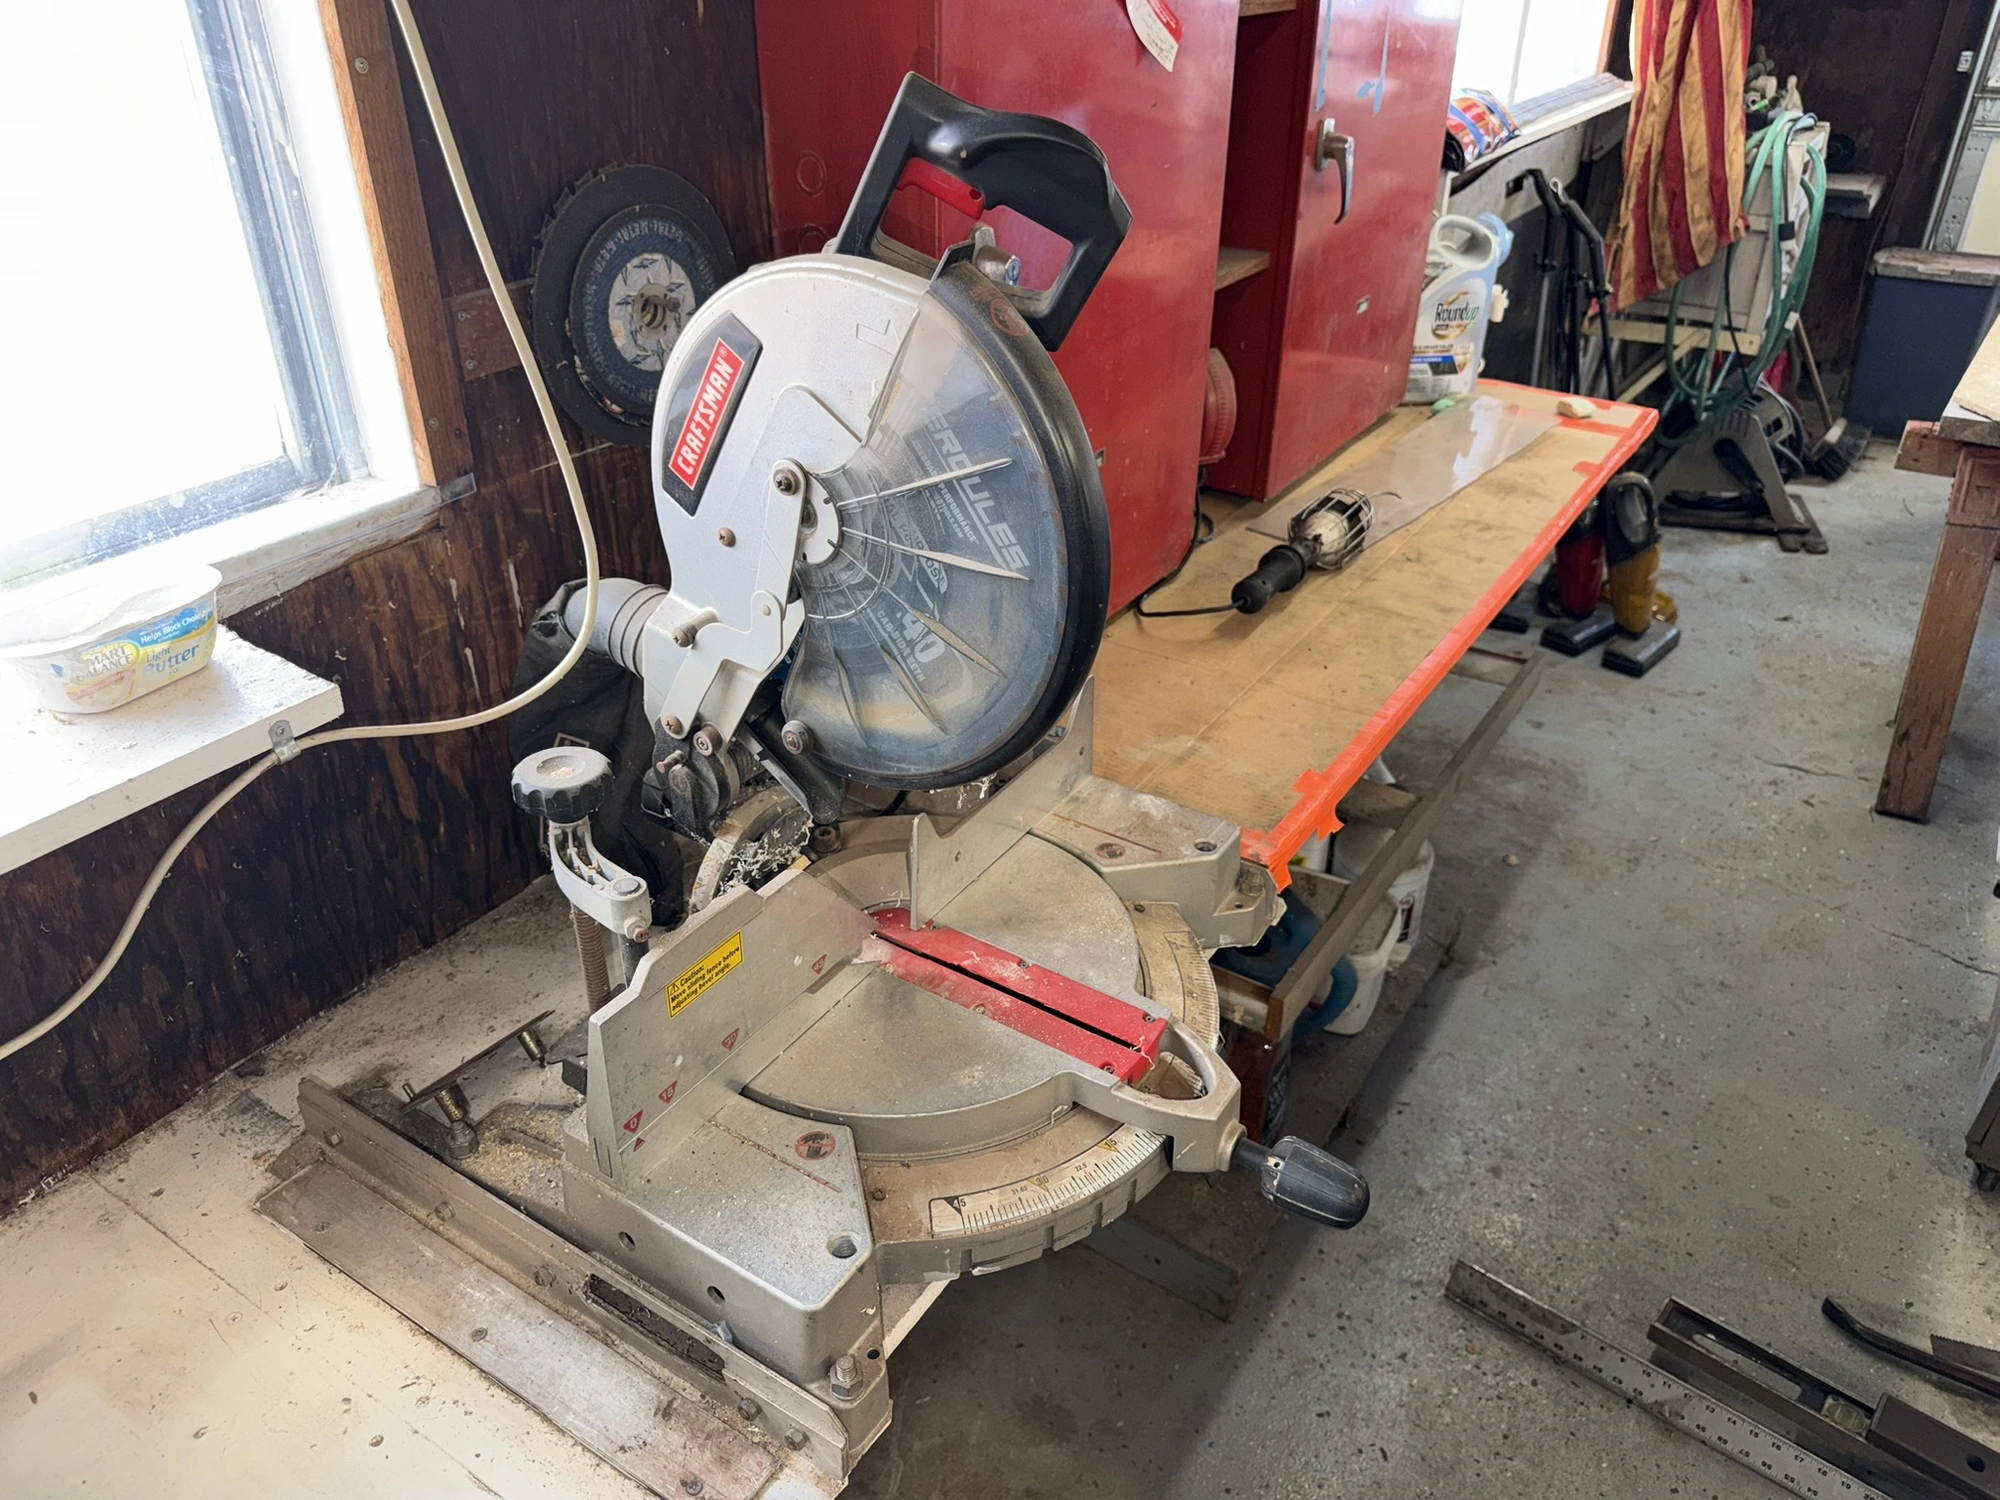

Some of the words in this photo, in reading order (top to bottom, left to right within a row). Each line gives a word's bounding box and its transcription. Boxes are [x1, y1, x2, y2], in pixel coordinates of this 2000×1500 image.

[1434, 301, 1480, 324] Roundup
[676, 356, 734, 475] CRAFTSMAN
[922, 405, 1031, 570] ERCULES
[140, 631, 162, 644] Helps
[162, 621, 181, 635] Block
[896, 611, 946, 663] 40
[87, 643, 129, 667] MART
[146, 646, 171, 663] Light
[671, 988, 686, 1003] Move
[687, 973, 706, 990] sliding
[706, 960, 722, 975] fence
[722, 946, 740, 963] before
[672, 987, 698, 1011] adjusting
[698, 973, 714, 990] bevel
[680, 964, 705, 987] Caution:
[661, 1086, 674, 1101] 15
[952, 1198, 967, 1210] 45
[1104, 1138, 1118, 1149] 15
[1727, 1417, 1737, 1426] 14
[1794, 1454, 1805, 1463] 17
[1841, 1480, 1852, 1490] 19
